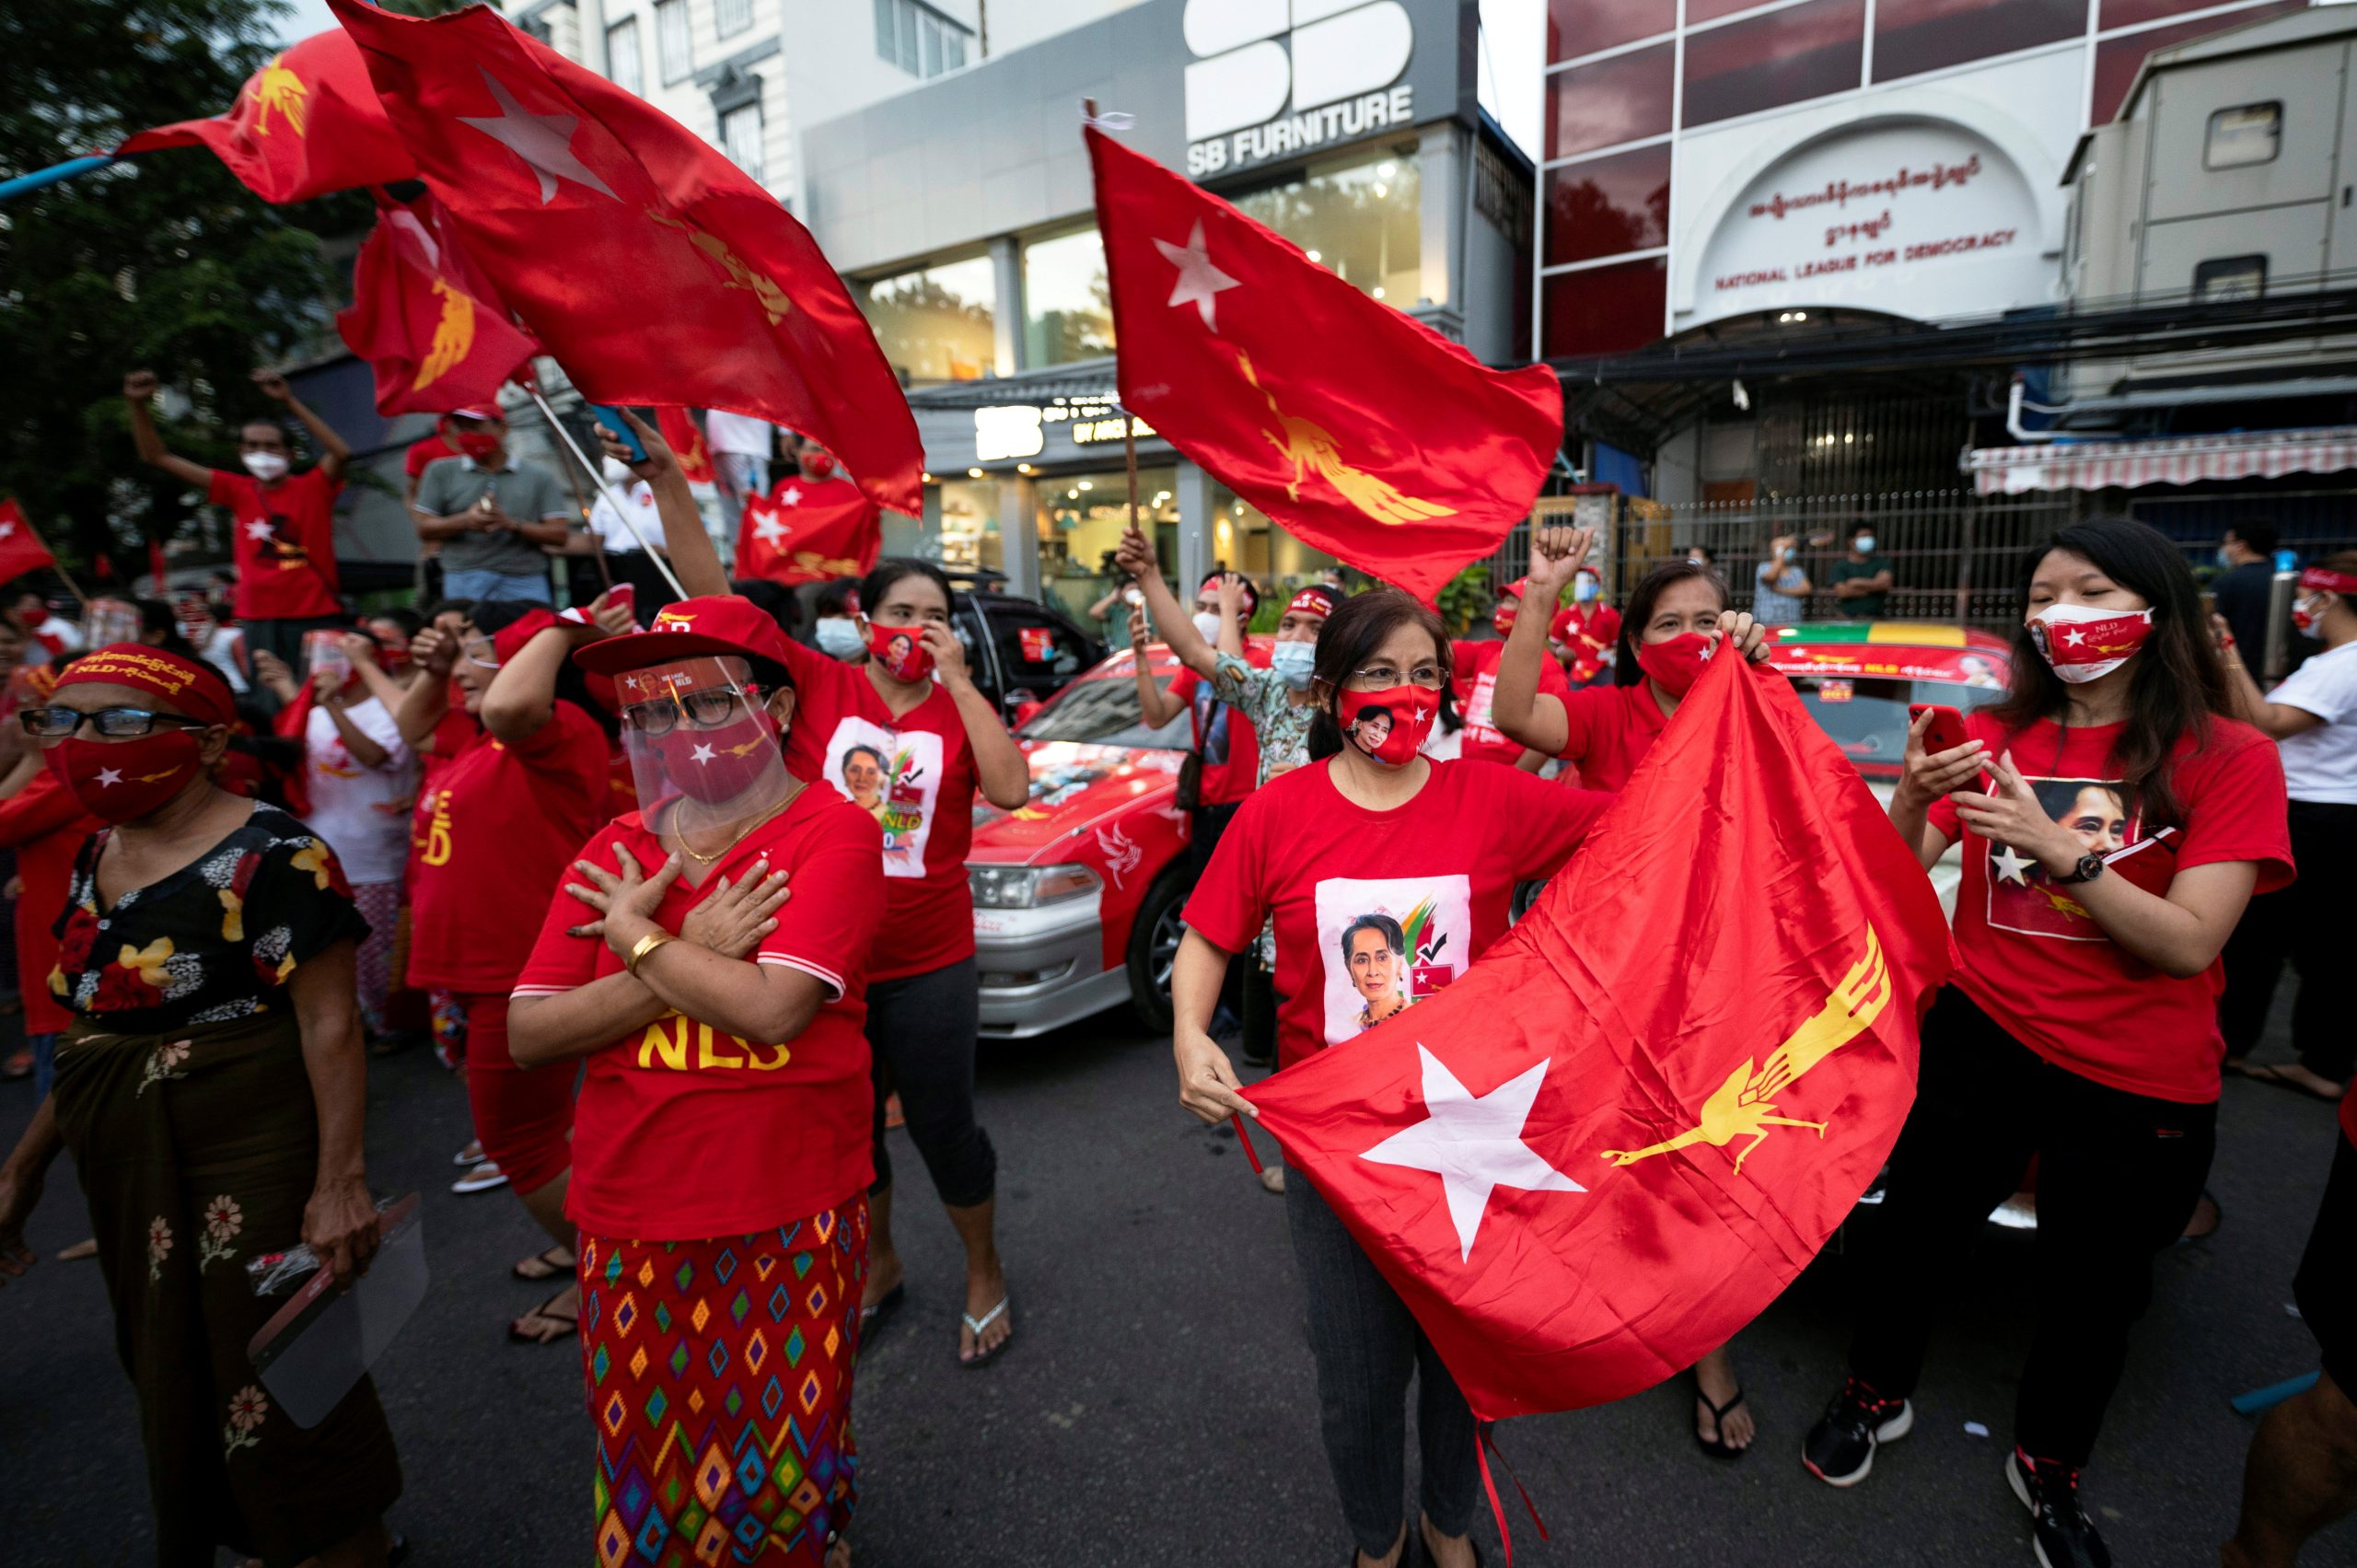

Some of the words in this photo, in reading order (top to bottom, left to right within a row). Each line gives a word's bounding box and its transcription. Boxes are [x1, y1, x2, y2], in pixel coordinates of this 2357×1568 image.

[1187, 138, 1227, 176] SB
[1234, 86, 1413, 164] FURNITURE
[1715, 267, 1788, 292] NATIONAL
[1795, 254, 1857, 279] LEAGUE
[1864, 249, 1897, 269] FOR
[1904, 227, 2018, 261] DEMOCRACY
[2096, 621, 2119, 633] NLD
[75, 664, 118, 674] NLD
[882, 812, 923, 830] NLD
